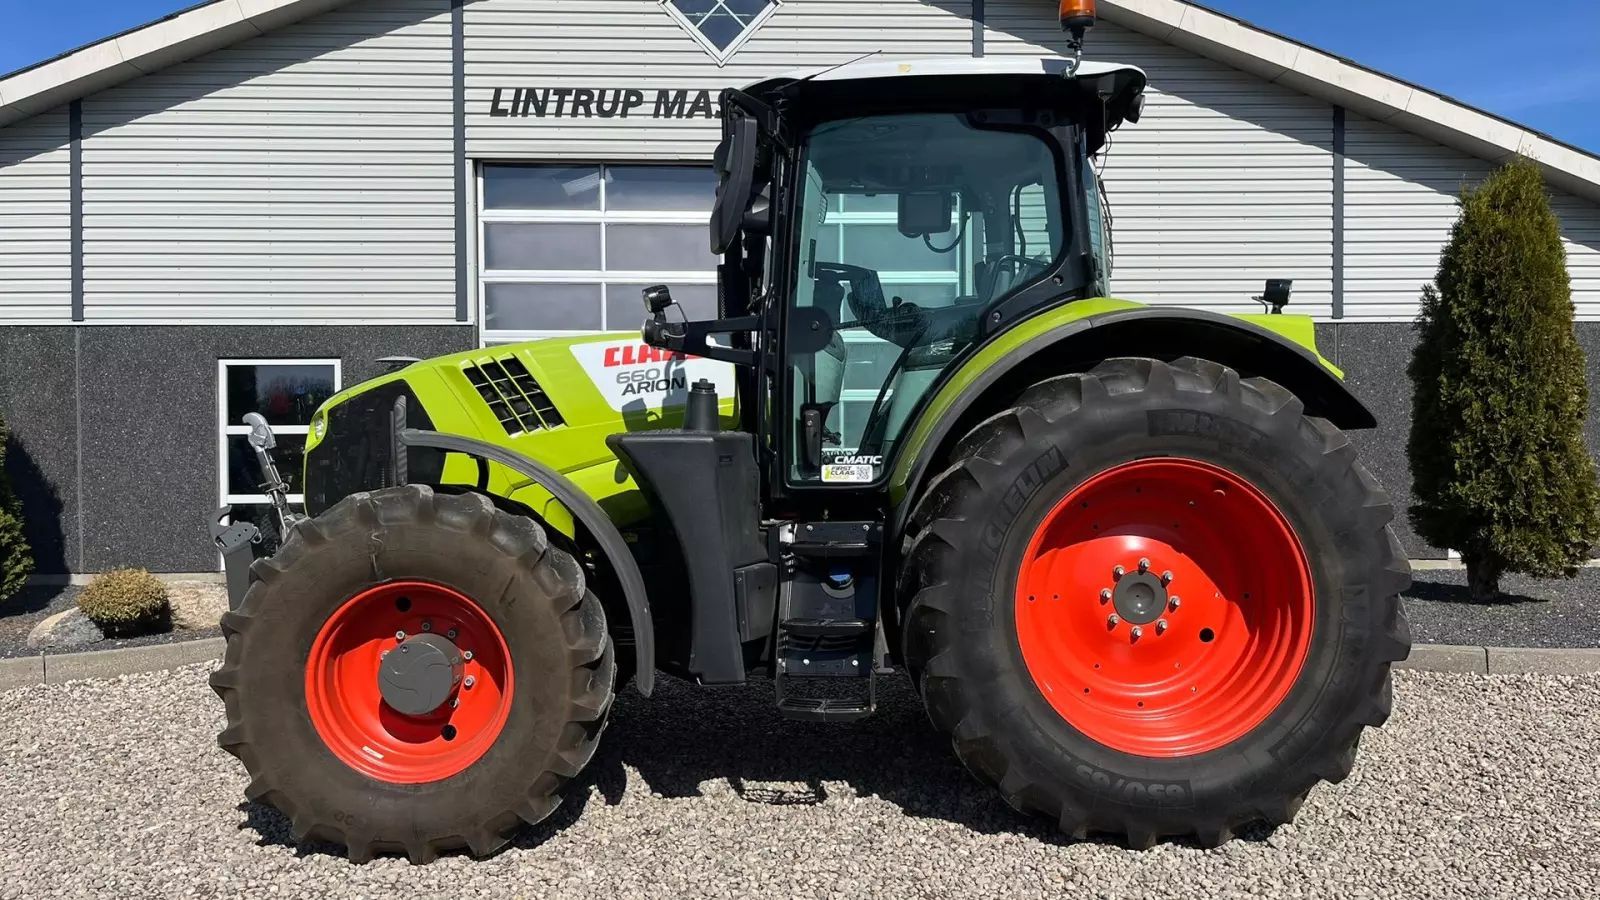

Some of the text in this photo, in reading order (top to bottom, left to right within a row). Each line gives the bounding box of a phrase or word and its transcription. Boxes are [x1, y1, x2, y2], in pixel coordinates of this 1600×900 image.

[490, 88, 722, 119] LINTRUP MA
[616, 368, 660, 384] 660
[621, 376, 685, 396] ARION
[834, 455, 883, 464] CMATIC
